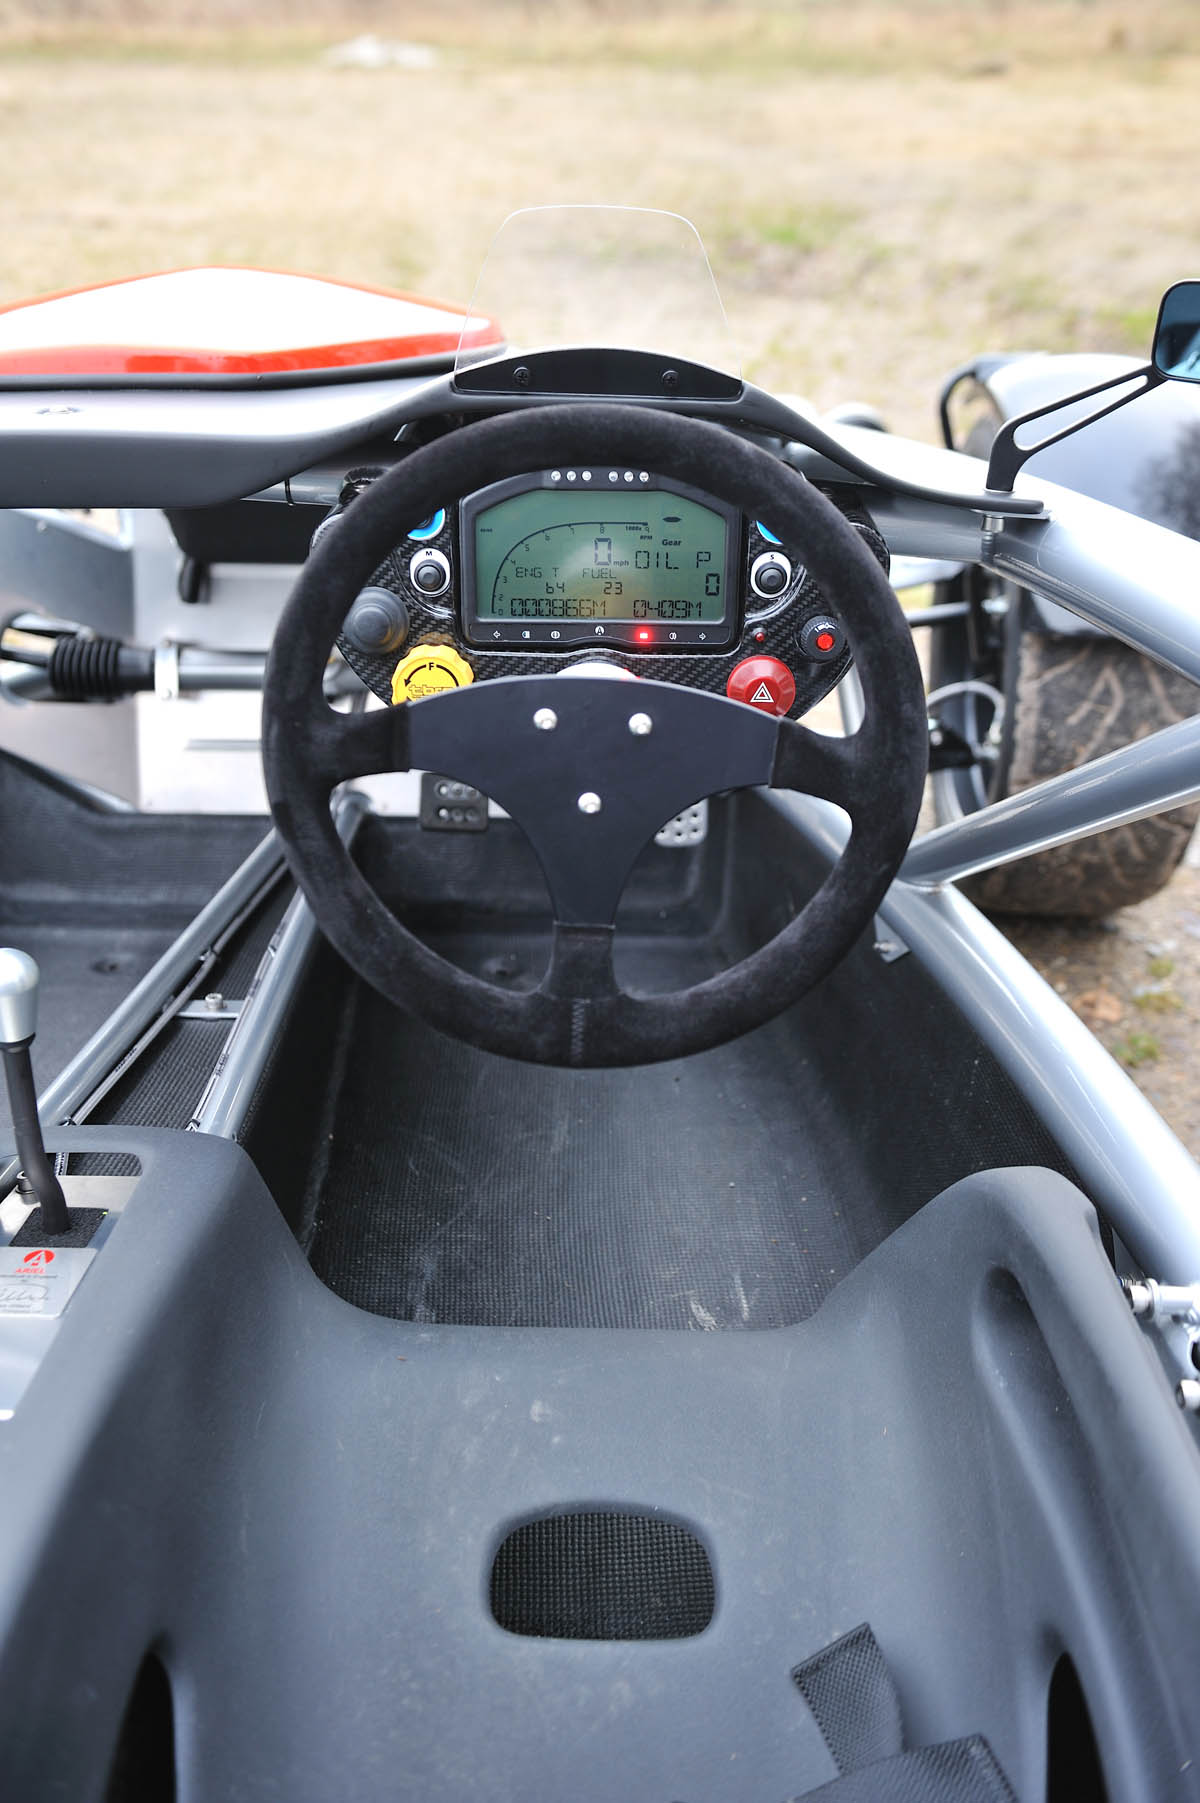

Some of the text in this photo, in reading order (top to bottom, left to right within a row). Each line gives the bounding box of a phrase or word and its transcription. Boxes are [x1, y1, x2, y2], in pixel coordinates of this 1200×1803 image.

[524, 544, 530, 552] 5
[594, 537, 612, 566] 0
[635, 550, 711, 570] OIL P
[515, 567, 560, 578] ENG T
[582, 567, 617, 579] FUEL
[603, 582, 623, 595] 23
[705, 573, 720, 596] 0
[428, 662, 435, 671] F
